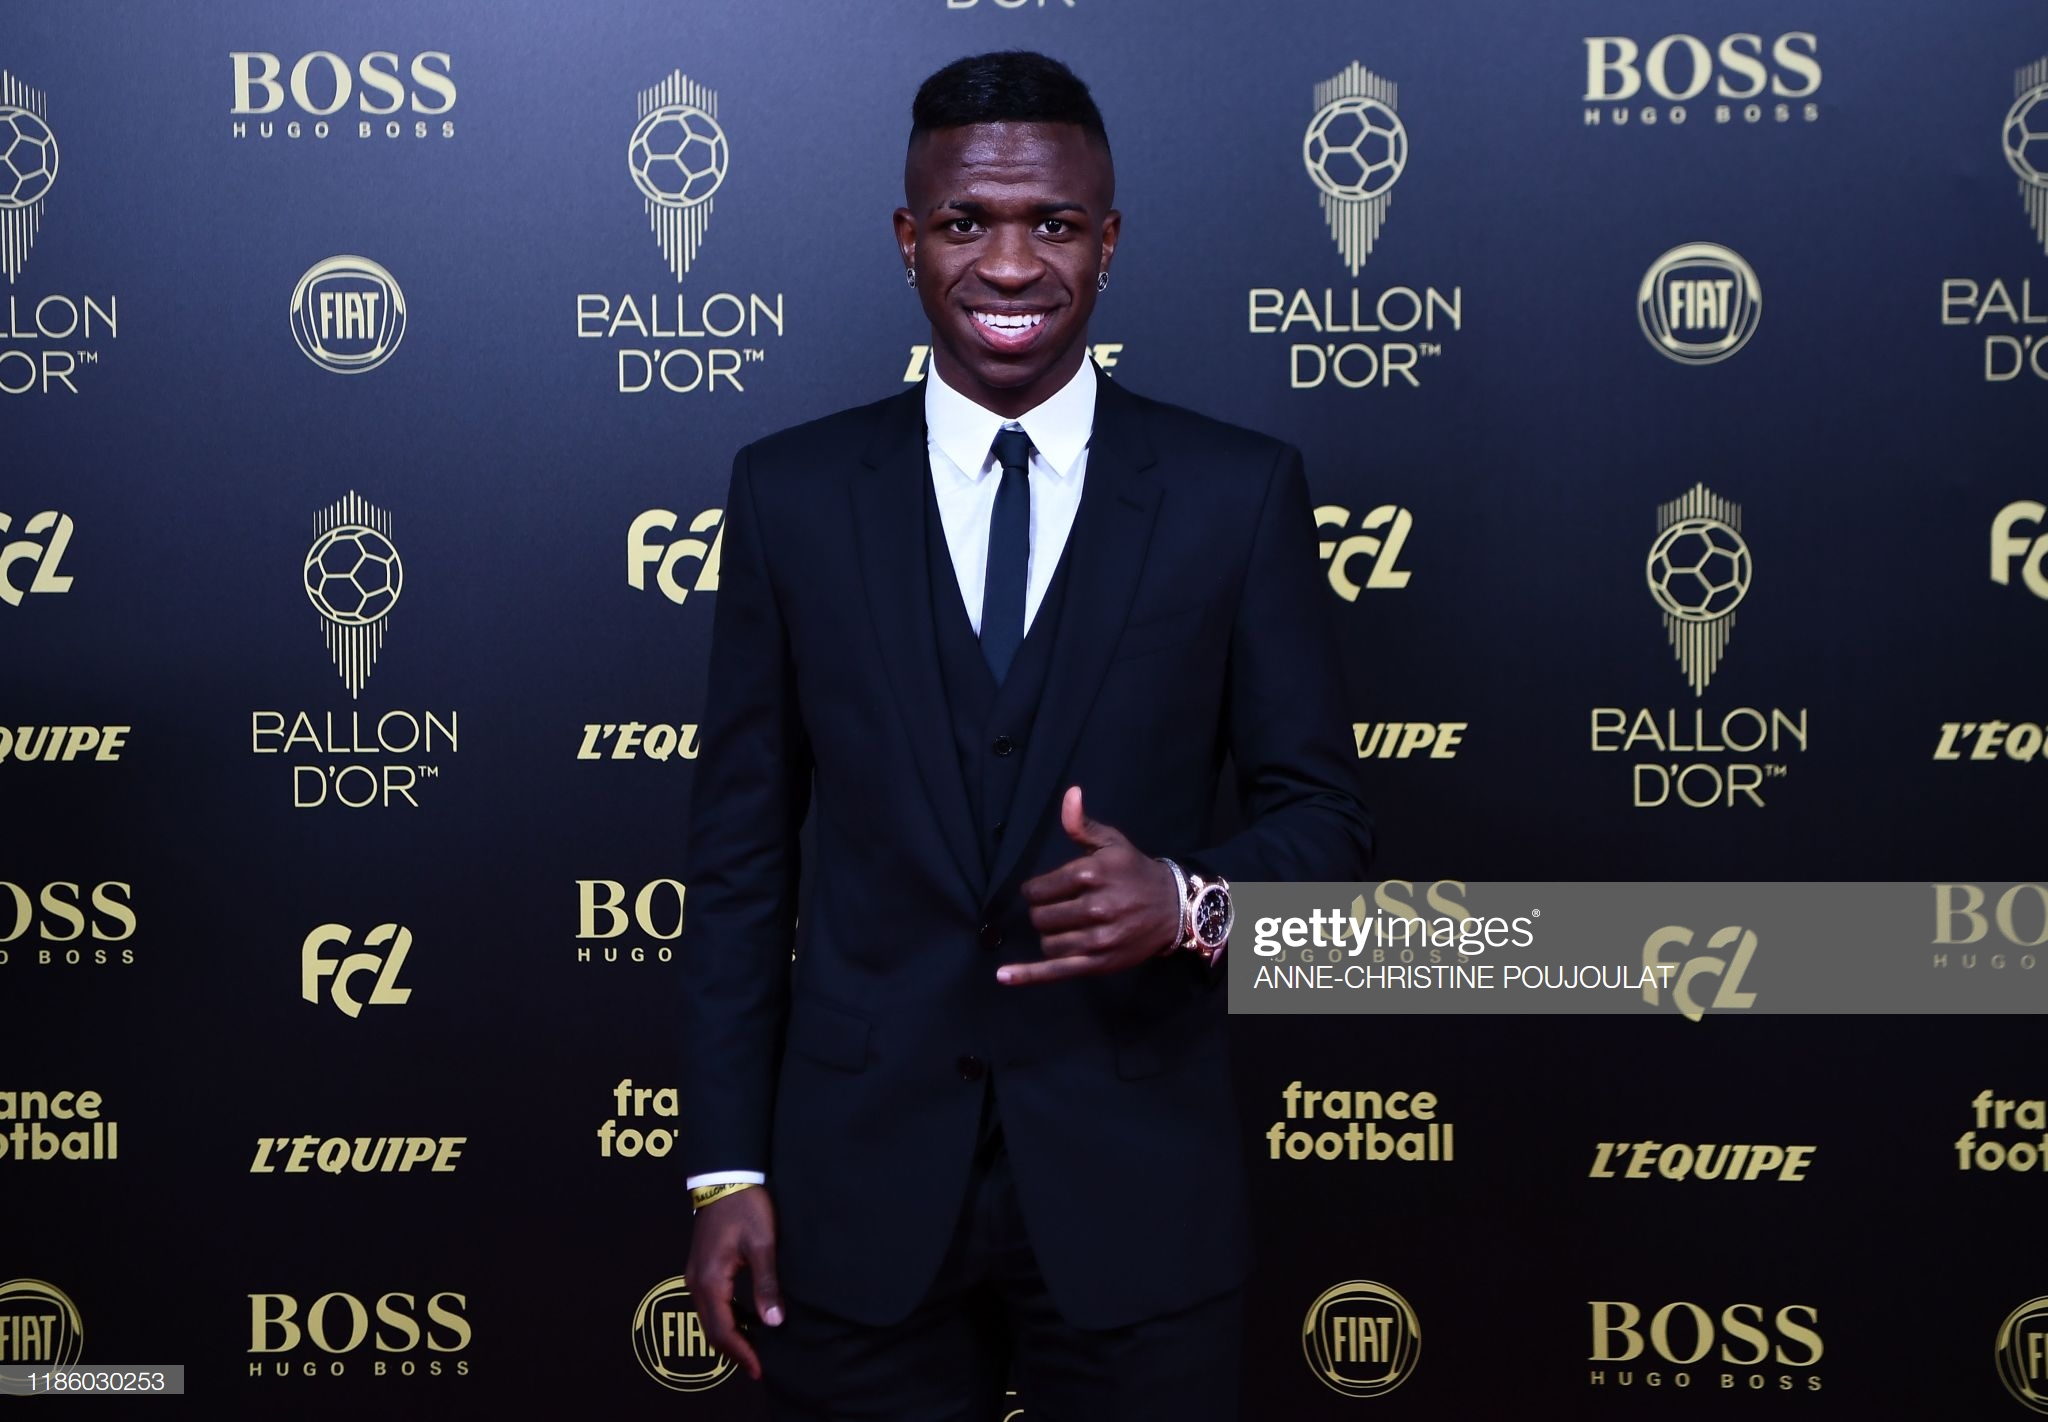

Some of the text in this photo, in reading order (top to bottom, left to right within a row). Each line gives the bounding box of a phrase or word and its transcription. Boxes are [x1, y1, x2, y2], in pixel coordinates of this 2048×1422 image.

[229, 51, 457, 115] BOSS
[1584, 32, 1822, 100] BOSS
[233, 121, 455, 138] HUGO BOSS
[1584, 103, 1818, 125] HUGO BOSS
[320, 291, 379, 340] FIAT
[577, 293, 784, 338] BALLON
[1249, 286, 1461, 333] BALLON
[1669, 279, 1733, 330] FIAT
[1941, 278, 2048, 325] BAL
[252, 710, 458, 753] BALLON
[1591, 707, 1807, 752] BALLON
[1933, 720, 2048, 762] L'ÉQ
[575, 878, 686, 940] BO
[1930, 884, 2048, 947] BO
[39, 949, 134, 965] BOSS
[577, 947, 672, 962] HUGO
[1372, 949, 1470, 963] BOSS
[1933, 953, 2036, 969] HUGO
[613, 1078, 679, 1117] fra
[1282, 1080, 1438, 1121] france
[1972, 1089, 2046, 1130] fra
[597, 1119, 679, 1158] foo
[1265, 1122, 1454, 1162] football
[0, 1315, 57, 1361] FIAT
[246, 1292, 472, 1354] BOSS
[662, 1311, 716, 1357] FIA
[1333, 1316, 1394, 1363] FIAT
[1587, 1301, 1824, 1367] BOSS
[249, 1360, 469, 1377] HUGO BOSS
[1591, 1371, 1822, 1391] HUGO BOSS
